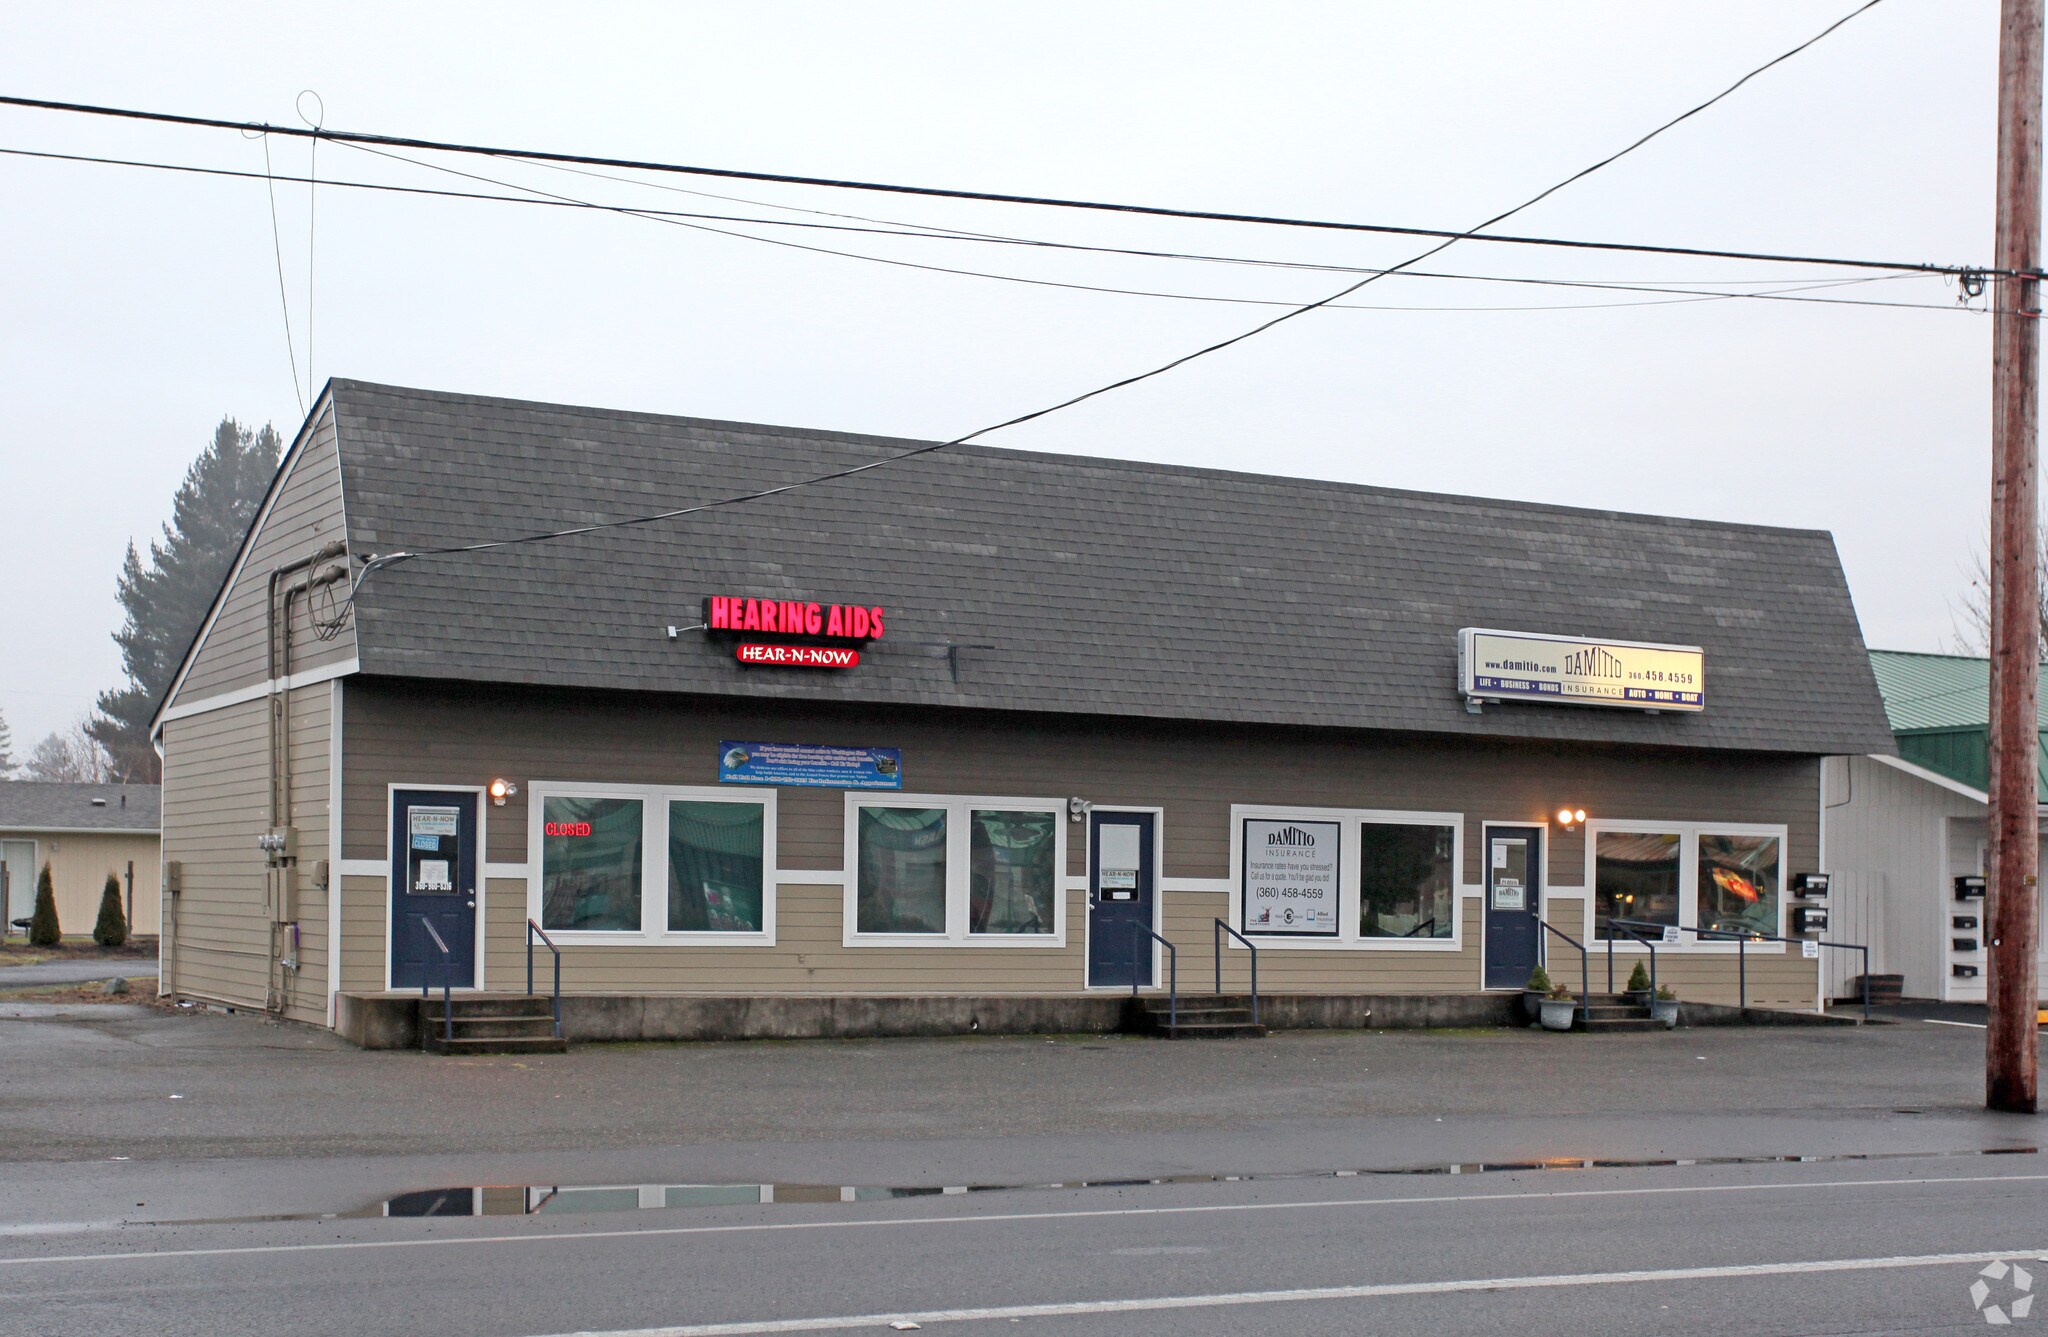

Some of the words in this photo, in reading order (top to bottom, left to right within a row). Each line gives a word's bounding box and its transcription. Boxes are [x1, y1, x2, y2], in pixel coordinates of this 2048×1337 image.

[711, 596, 822, 635] HEARING
[827, 604, 885, 639] AIDS
[742, 647, 853, 665] HEAR-N-NOW
[1565, 646, 1622, 679] DAMITIO
[1485, 659, 1557, 674] www.damitio.com
[1629, 670, 1693, 684] 360.458.4559
[1479, 678, 1491, 687] LIFE
[1500, 679, 1530, 690] BUSINESS
[1539, 682, 1559, 692] BONDS
[1562, 684, 1623, 696] INSURANCE
[1629, 689, 1647, 698] AUTO
[1655, 691, 1674, 700] HOME
[1681, 692, 1699, 702] BOAT
[413, 815, 455, 823] HEAR-N-NOW
[545, 822, 591, 837] CLOSED
[1268, 826, 1315, 847] DAMITIO
[414, 840, 437, 849] CLOSED
[1265, 849, 1316, 858] INSURANCE
[1250, 861, 1274, 870] Insurance
[1274, 862, 1287, 870] rates
[1287, 862, 1299, 870] have
[1300, 864, 1310, 872] you
[1310, 863, 1333, 871] stressed?
[1250, 871, 1259, 880] Call
[1259, 873, 1264, 881] us
[1299, 873, 1305, 881] be
[1305, 873, 1314, 883] glad
[1314, 875, 1322, 884] you
[1256, 887, 1279, 900] (360)
[1281, 888, 1323, 899] 458-4559
